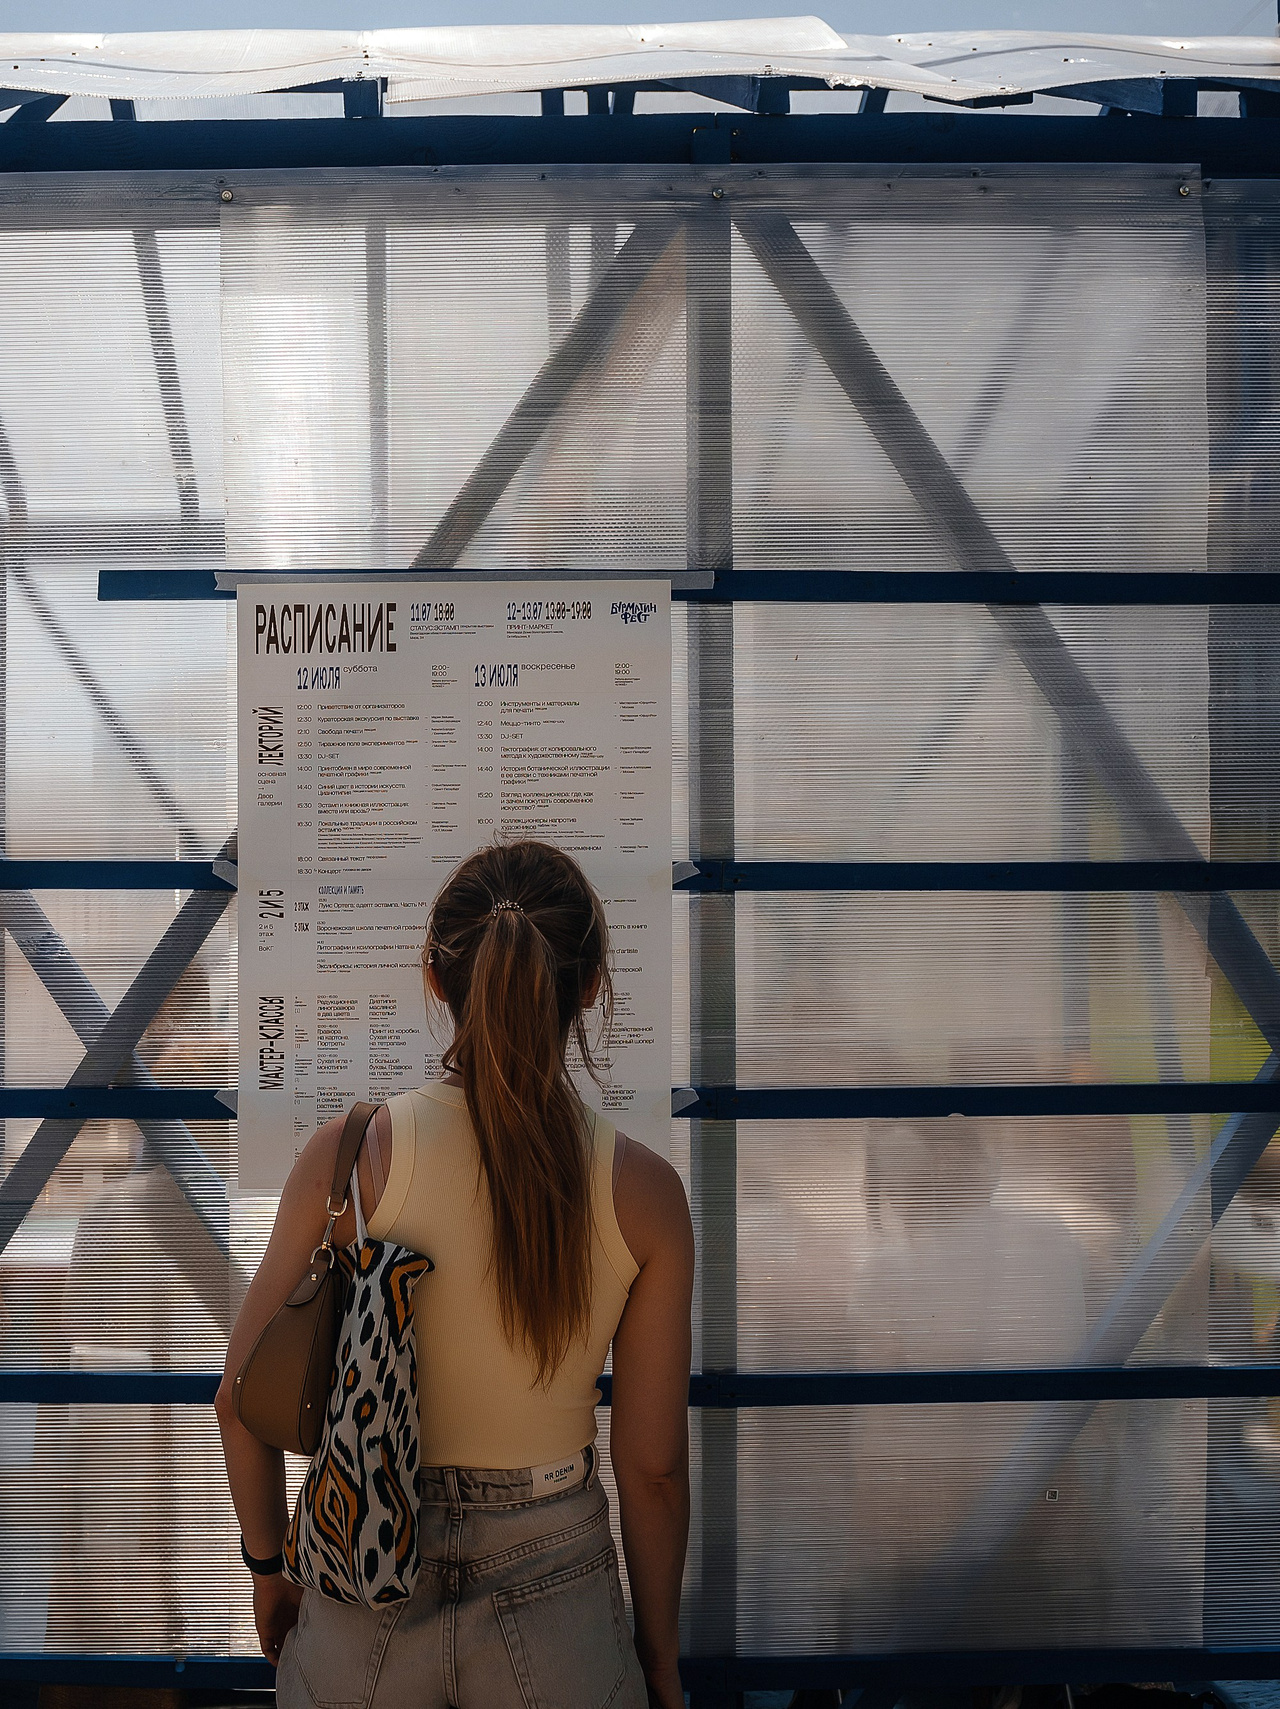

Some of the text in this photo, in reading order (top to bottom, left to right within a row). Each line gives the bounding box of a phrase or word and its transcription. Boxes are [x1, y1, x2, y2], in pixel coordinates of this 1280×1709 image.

[434, 603, 454, 621] 18:00
[610, 600, 657, 615] БУРМАТИН
[621, 612, 650, 624] ФЕСТ
[255, 602, 397, 654] РАСПИСАНИЕ
[297, 664, 378, 690] 12 ИЮЛЯ суббота
[474, 664, 576, 687] 13 ИЮЛЯ воскресенье
[251, 706, 284, 766] ЛЕКТОРИЙ
[258, 889, 285, 919] 2 И 5
[258, 996, 284, 1090] МАСТЕР-КЛАССЫ
[544, 1463, 574, 1481] RR DENIM
